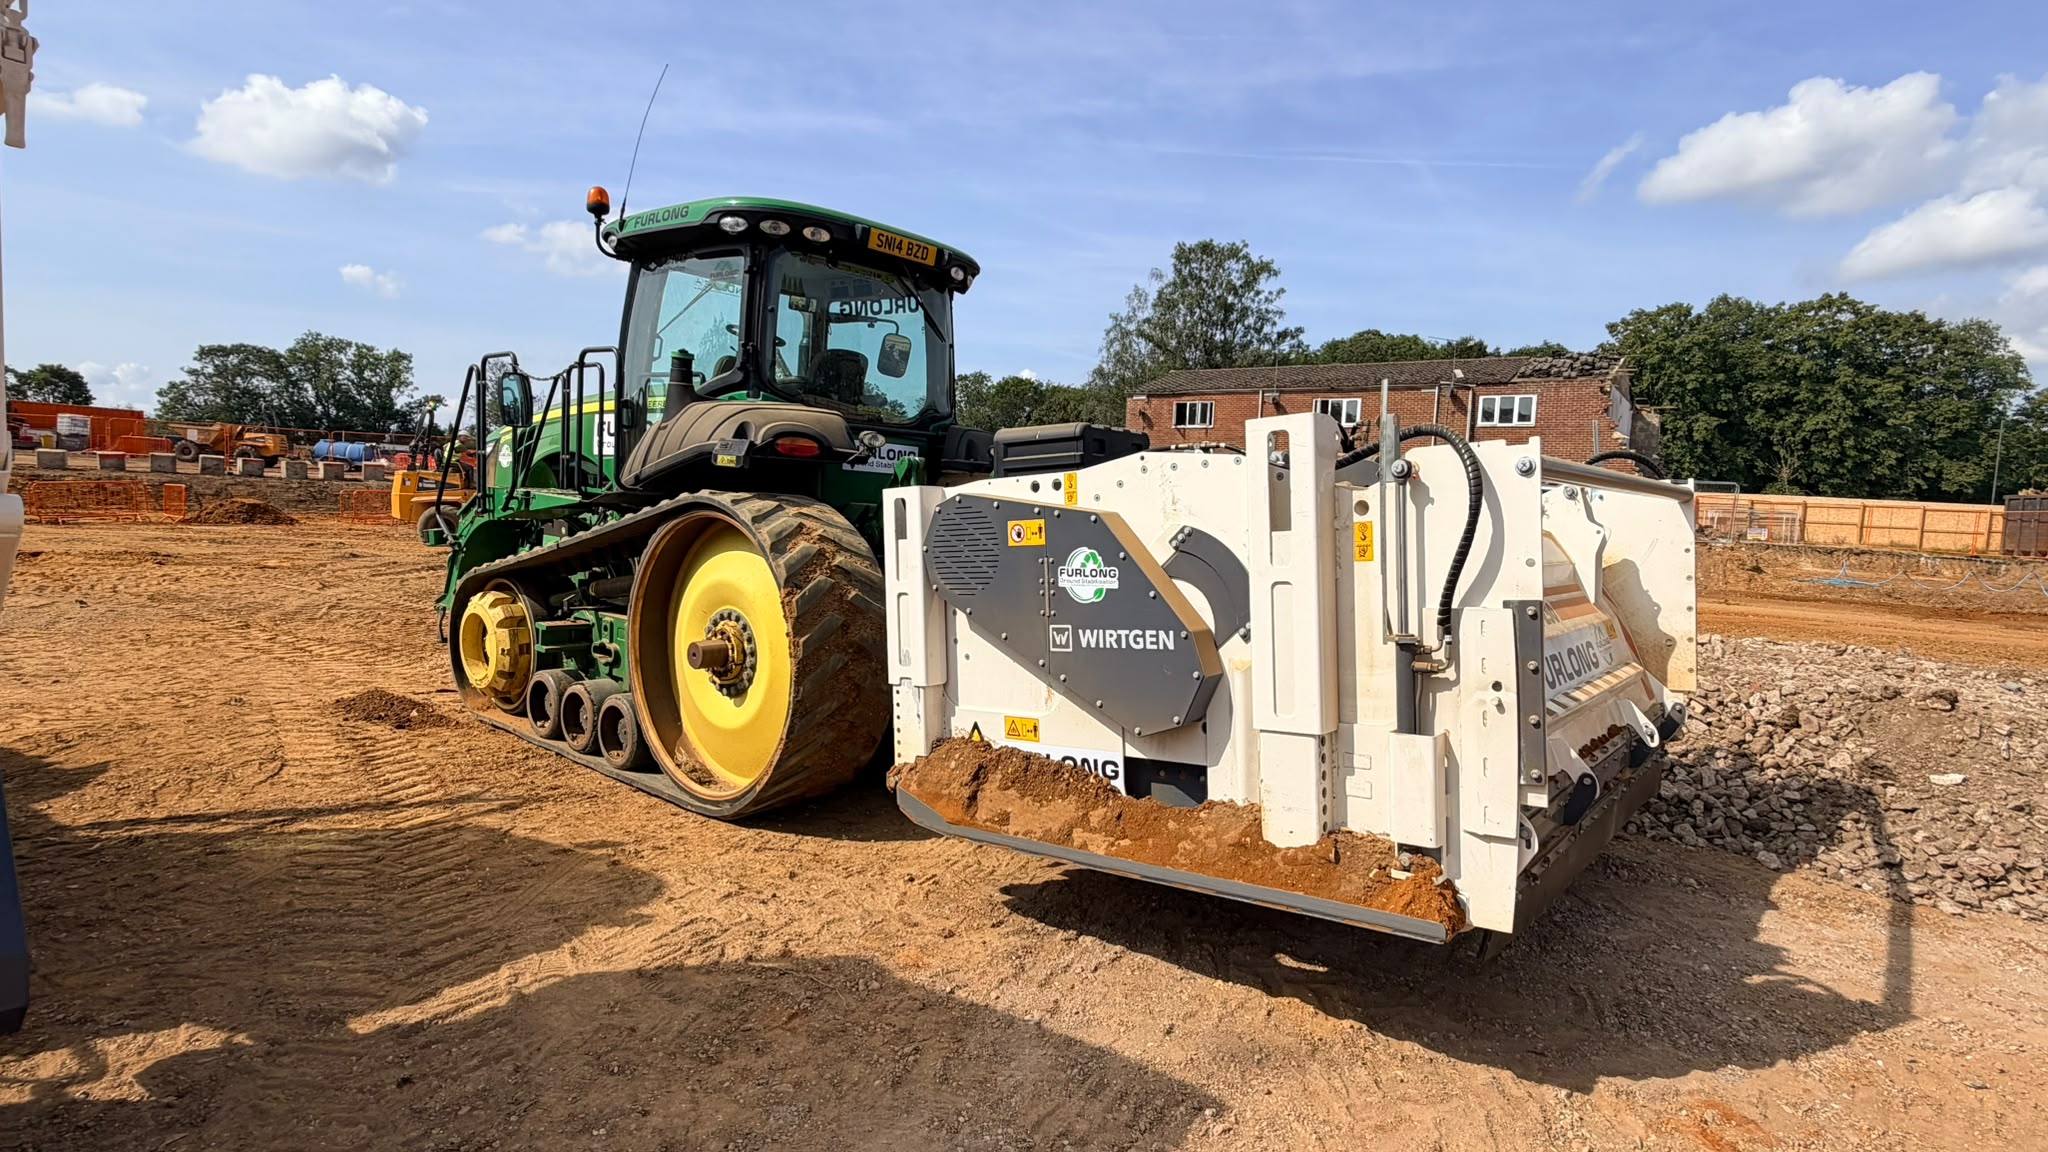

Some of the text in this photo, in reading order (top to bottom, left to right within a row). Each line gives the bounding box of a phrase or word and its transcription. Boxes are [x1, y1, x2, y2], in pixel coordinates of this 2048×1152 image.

[633, 205, 690, 229] FURLONG
[876, 233, 929, 261] SN14 BZD
[1060, 568, 1117, 578] FURLONG
[1078, 629, 1175, 650] WIRTGEN
[1545, 641, 1600, 690] URLONG
